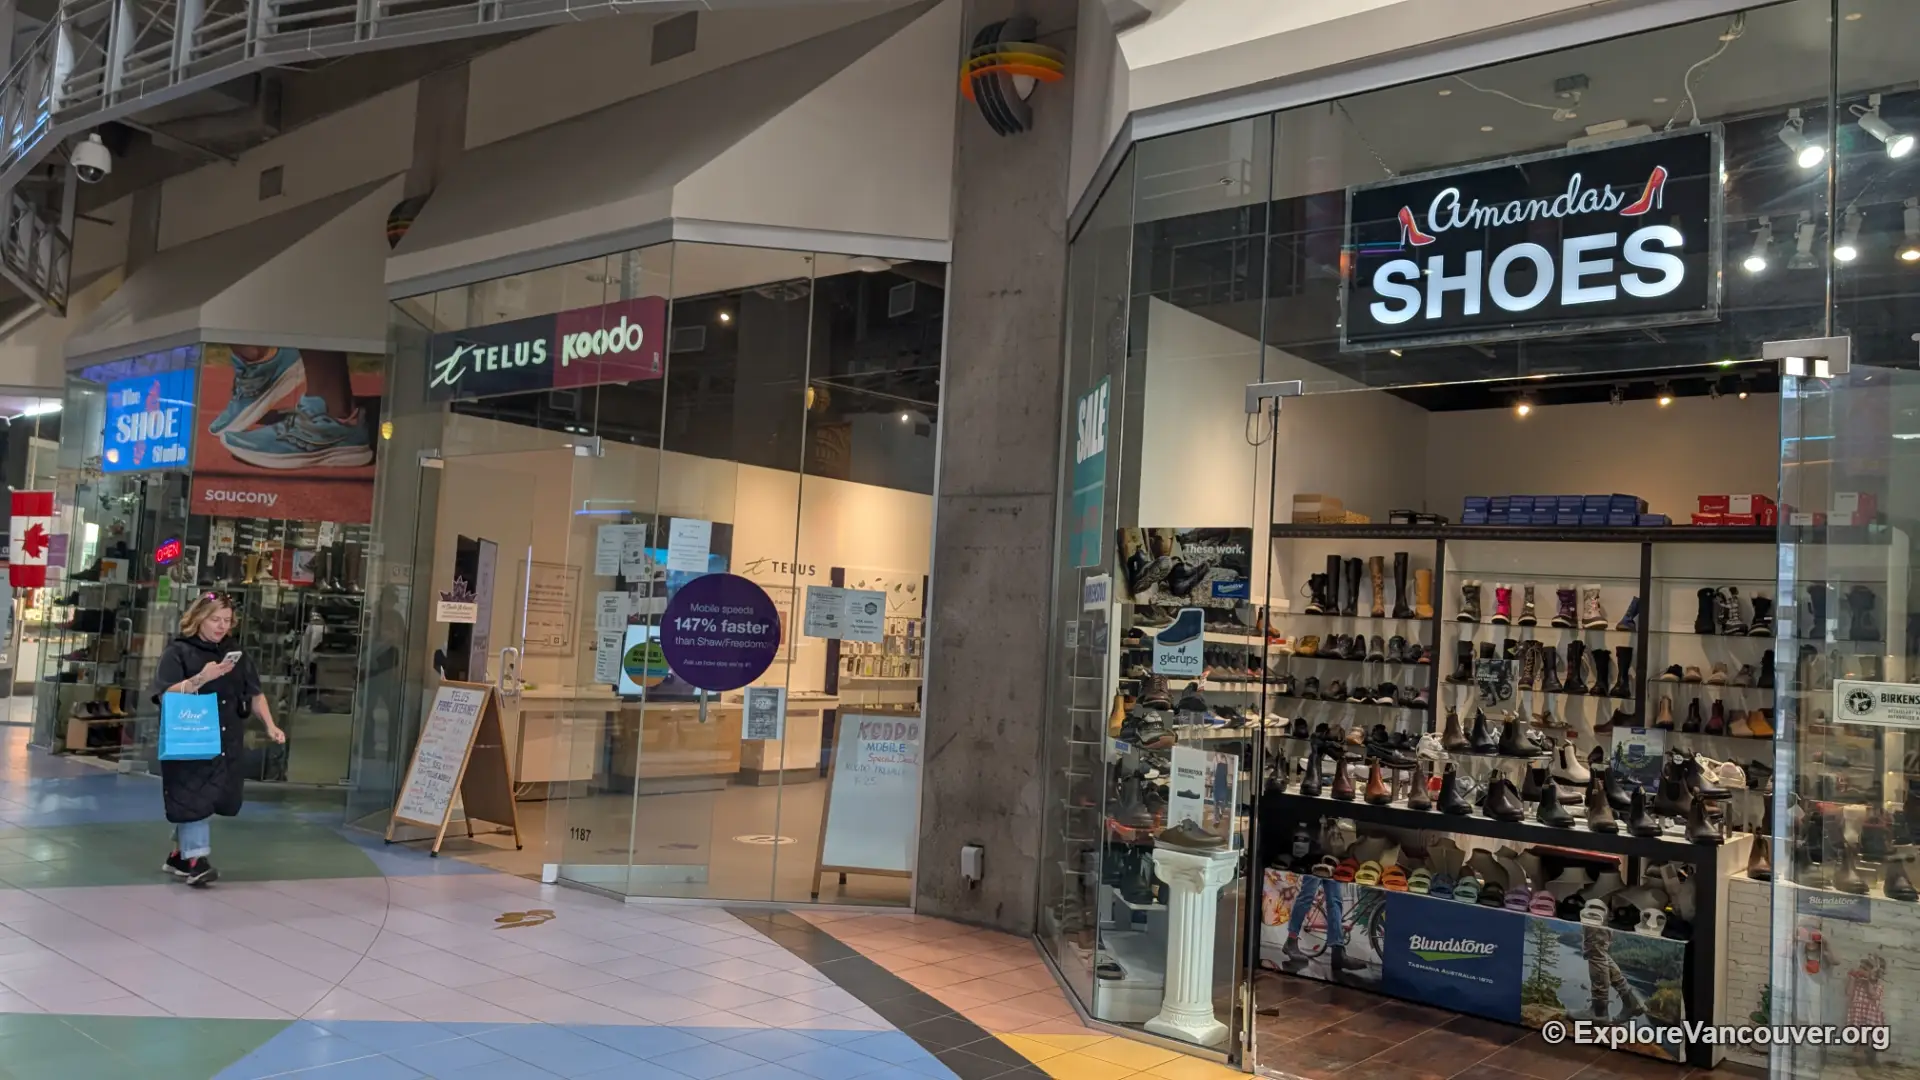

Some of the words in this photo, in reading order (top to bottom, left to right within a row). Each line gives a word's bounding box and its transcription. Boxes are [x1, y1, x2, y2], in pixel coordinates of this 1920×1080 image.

[1370, 224, 1686, 325] SHOES
[472, 338, 547, 373] TELUS
[115, 407, 179, 444] SHOE
[1076, 381, 1108, 465] SALE
[152, 443, 187, 464] Studio
[205, 488, 278, 507] saucony
[155, 540, 181, 562] OPEN
[1184, 543, 1214, 554] These
[1216, 543, 1246, 555] work.
[771, 561, 816, 577] TELUS
[690, 603, 720, 613] Mobile
[722, 605, 754, 615] speeds
[674, 617, 717, 632] 147%
[721, 619, 769, 634] faster
[675, 635, 695, 645] than
[1160, 651, 1199, 667] glerups
[865, 742, 907, 753] MOBILE
[570, 826, 592, 842] 1187
